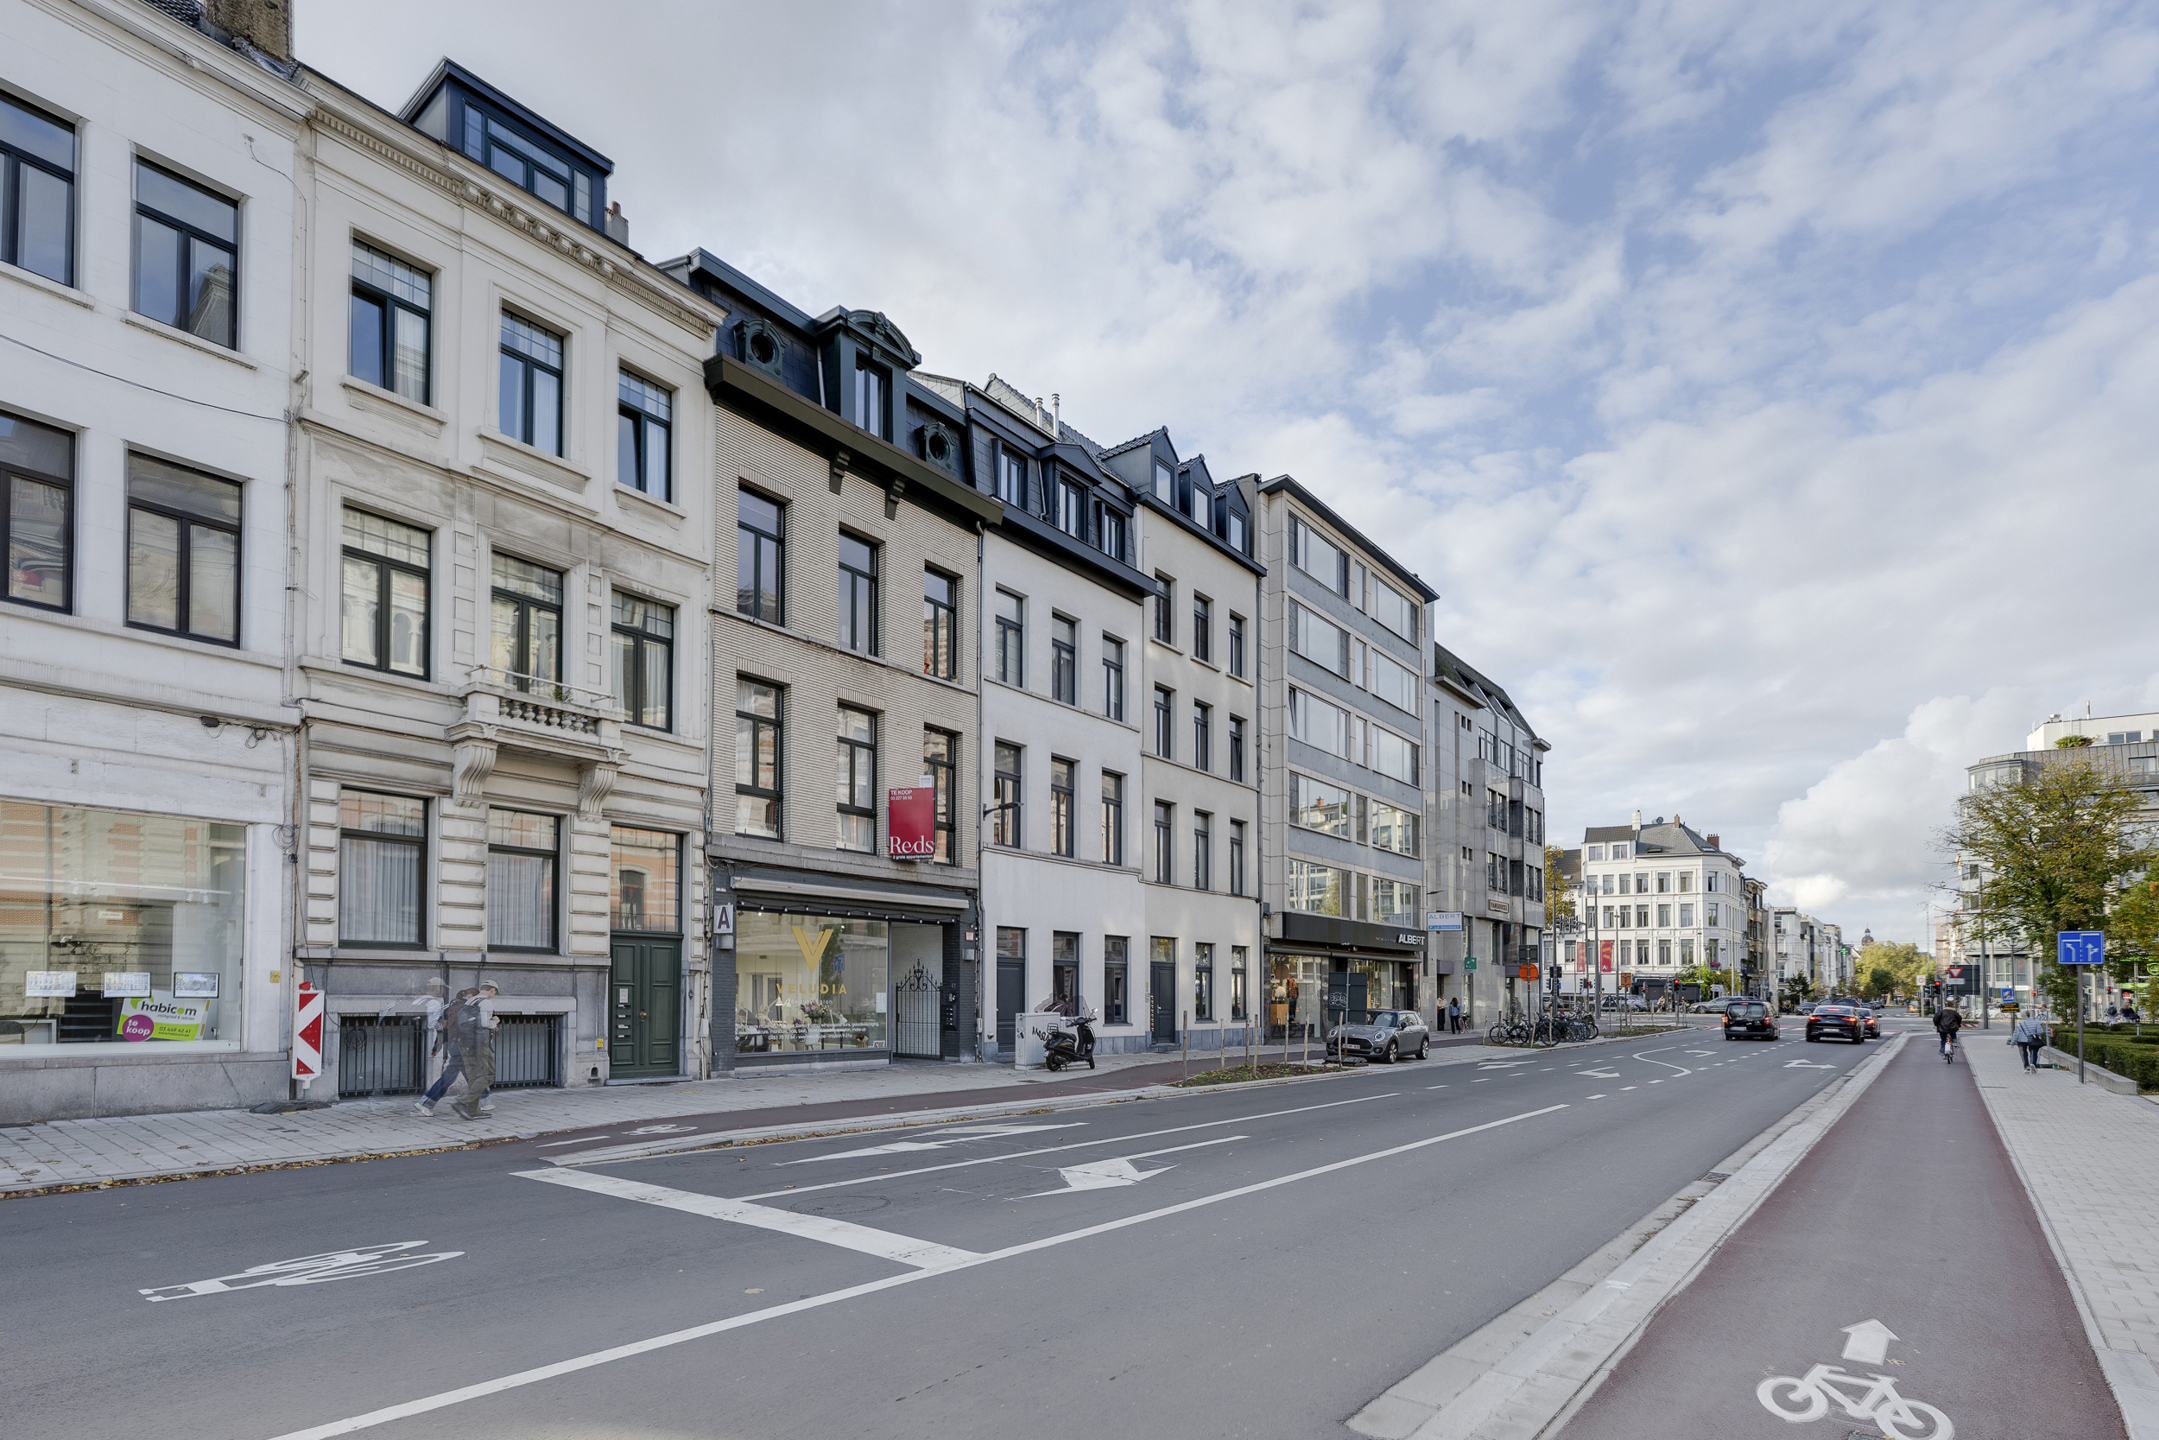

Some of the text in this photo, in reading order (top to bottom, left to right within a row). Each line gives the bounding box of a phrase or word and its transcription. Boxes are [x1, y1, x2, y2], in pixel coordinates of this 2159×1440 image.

[890, 835, 934, 854] Reds
[718, 907, 730, 929] A
[1398, 934, 1425, 946] ALBERT
[776, 984, 847, 994] VELUDIA
[141, 1001, 197, 1016] habicom
[126, 1026, 150, 1036] koop
